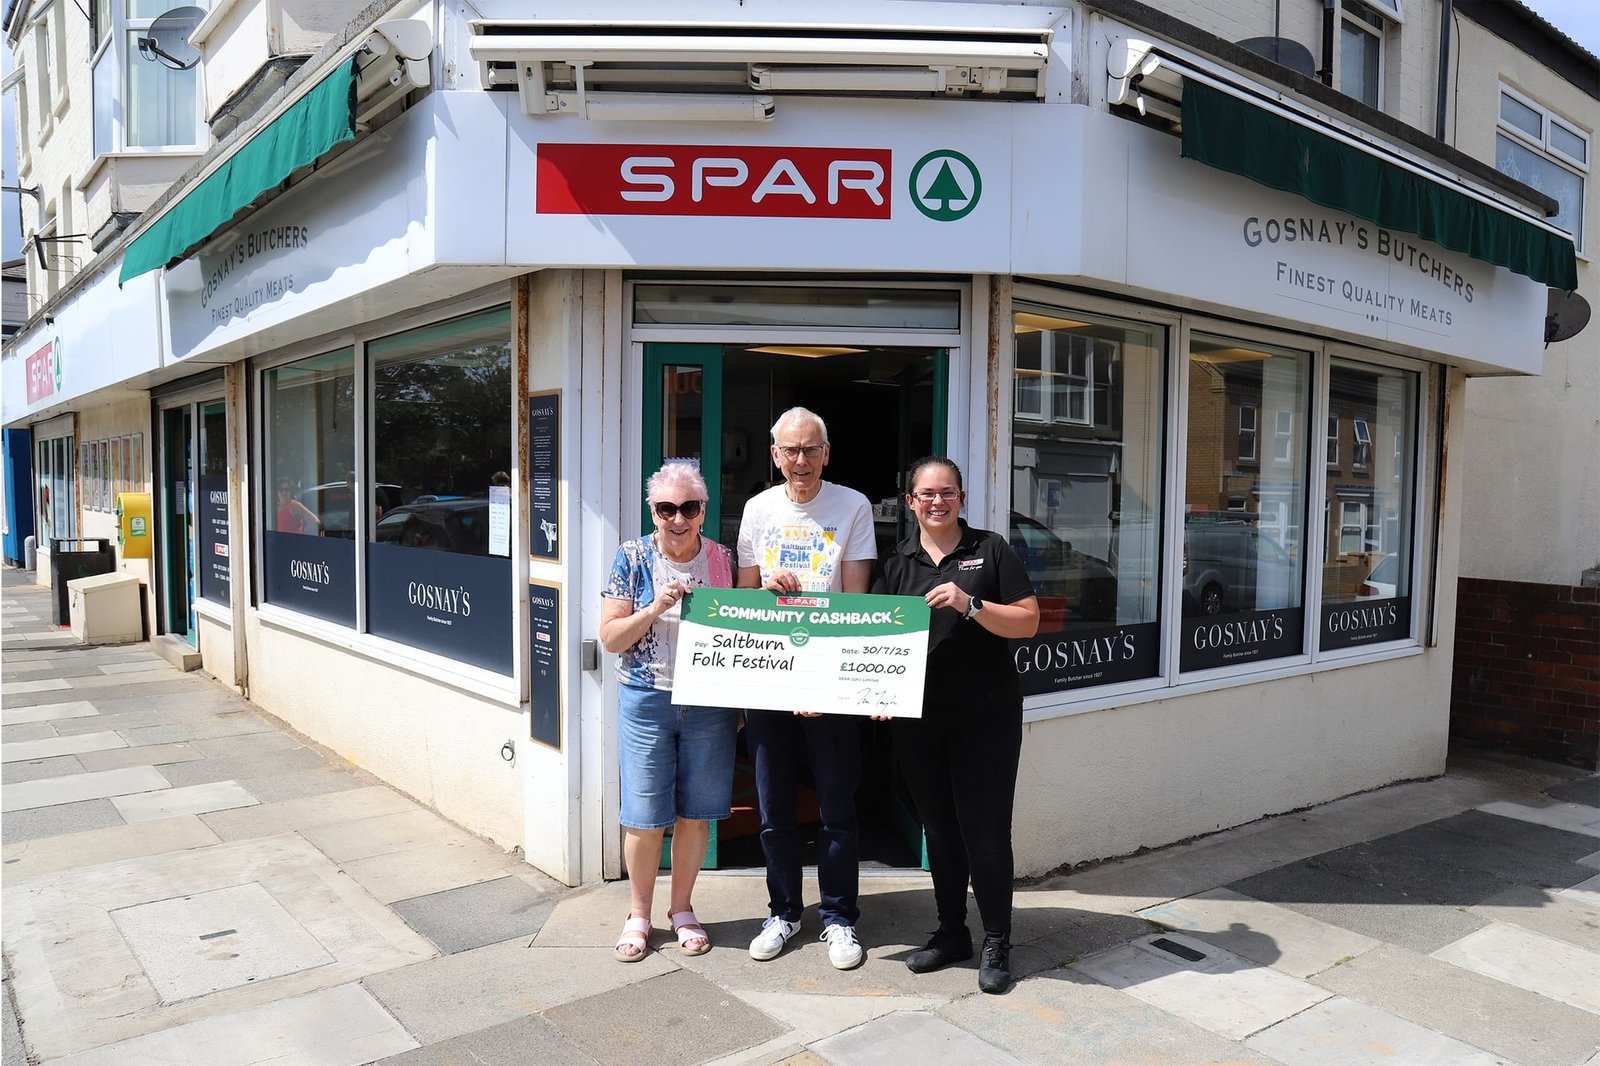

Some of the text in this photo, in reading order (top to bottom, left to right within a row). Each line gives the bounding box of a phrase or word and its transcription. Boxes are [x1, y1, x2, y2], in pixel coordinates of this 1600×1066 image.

[620, 156, 884, 206] SPAR
[201, 226, 308, 309] GOSNAY'S BUTCHERS
[1243, 217, 1474, 303] GOSNAY'S BUTCHERS
[211, 274, 294, 323] FINEST QUALITY MEATS
[1276, 261, 1453, 326] FINEST QUALITY MEATS
[780, 543, 812, 551] Saltburn
[780, 550, 810, 562] Folk
[290, 559, 330, 585] GOSNAY'S
[779, 561, 811, 569] Festival
[408, 581, 471, 617] GOSNAY'S
[786, 598, 817, 606] SPAR
[718, 605, 892, 625] COMMUNITY CASHBACK
[1328, 602, 1397, 633] GOSNAY'S
[712, 633, 785, 650] Saltburn
[1193, 614, 1284, 650] GOSNAY'S
[692, 651, 795, 671] Folk Festival
[862, 646, 911, 656] 30/7/25
[1014, 630, 1135, 674] GOSNAY'S
[840, 662, 906, 675] £1000.00
